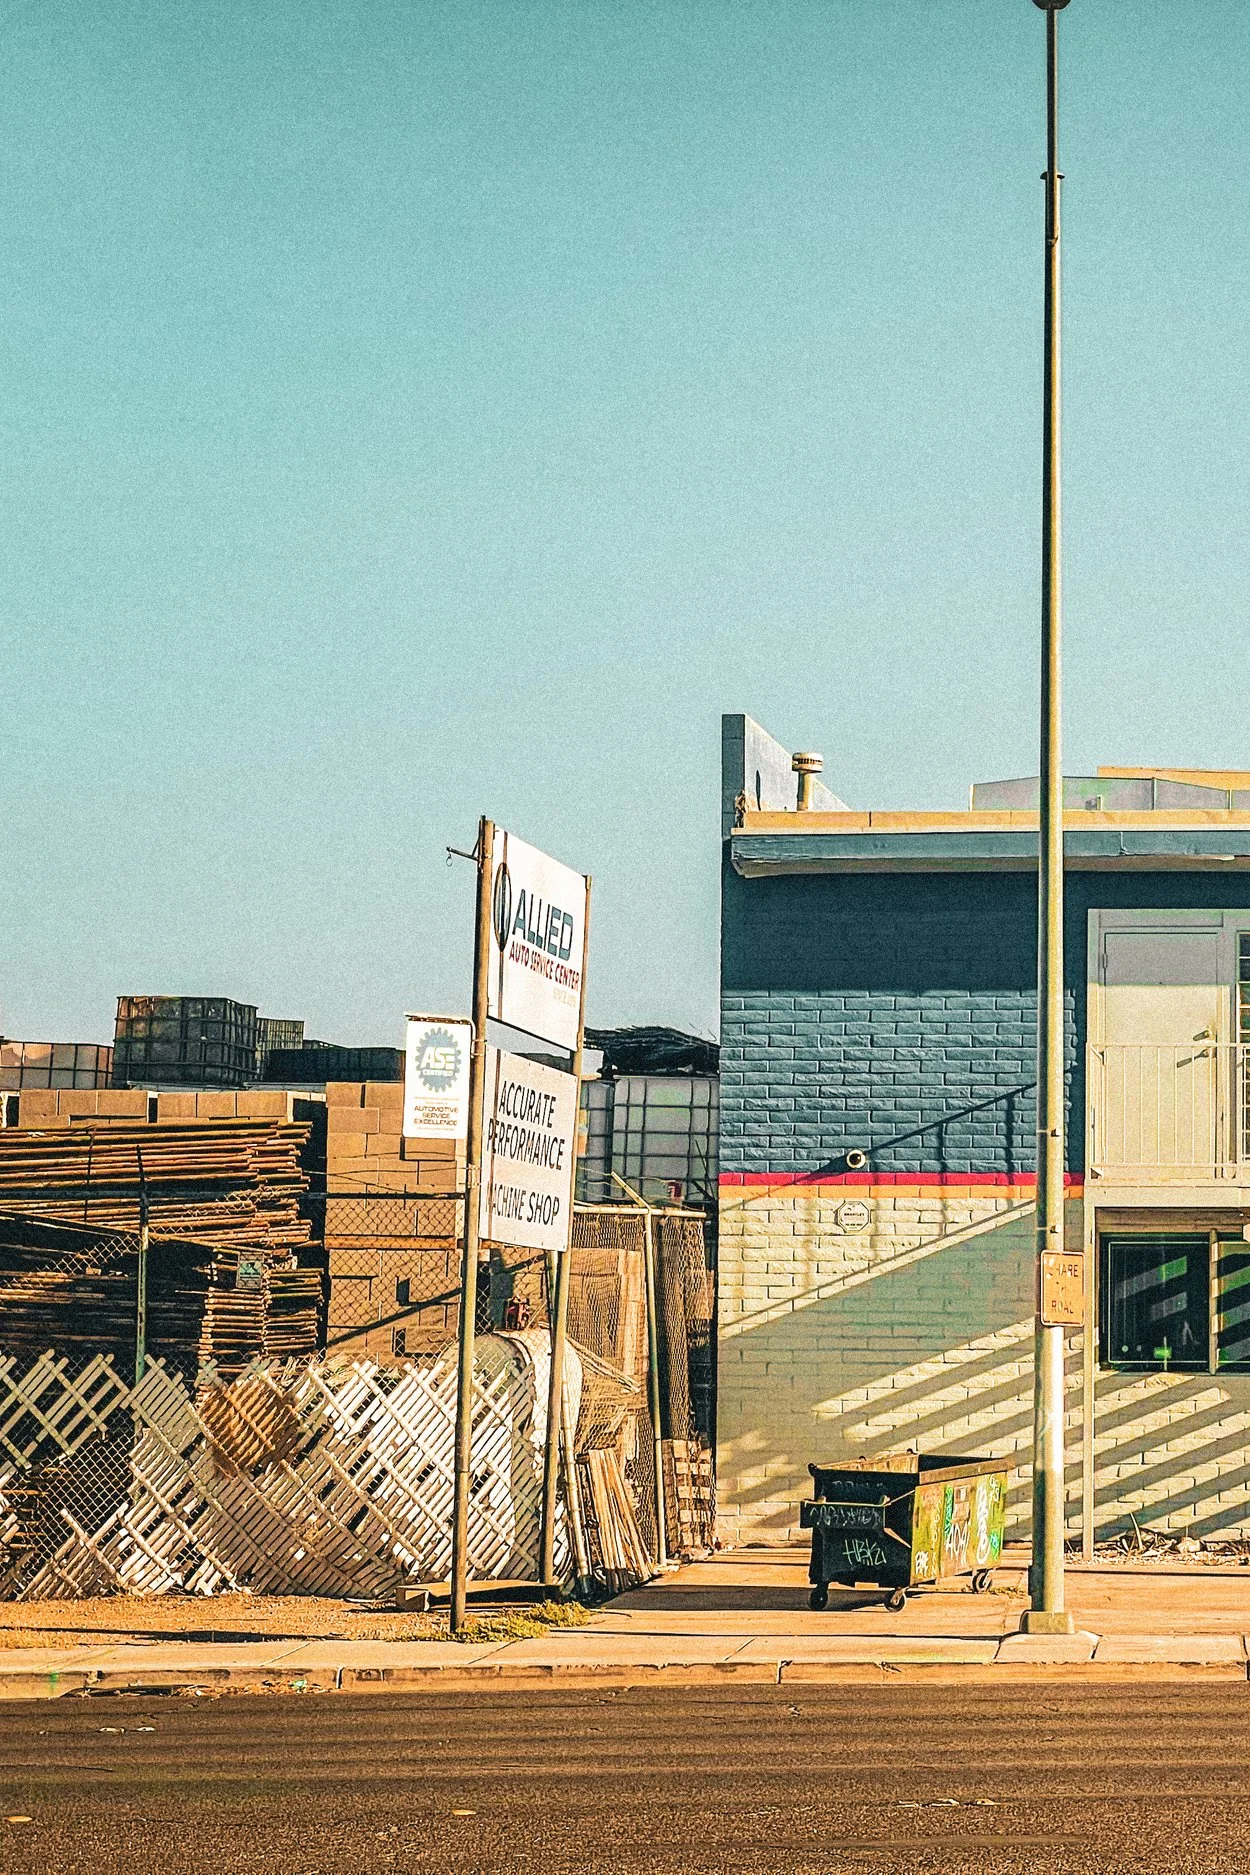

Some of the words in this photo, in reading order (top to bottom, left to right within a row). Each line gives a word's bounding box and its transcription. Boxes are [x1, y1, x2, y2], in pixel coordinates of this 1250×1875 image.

[512, 888, 573, 961] ALLIED
[509, 941, 530, 967] AUTO
[530, 950, 554, 980] SERVICE
[555, 963, 580, 992] CENTER
[421, 1046, 455, 1070] ASE
[413, 1118, 458, 1126] EXCELLENCE
[414, 1105, 458, 1113] AUTOMOTIVE
[499, 1080, 556, 1128] ACCURATE
[487, 1118, 565, 1170] PERFORMANCE
[527, 1191, 560, 1226] SHOP
